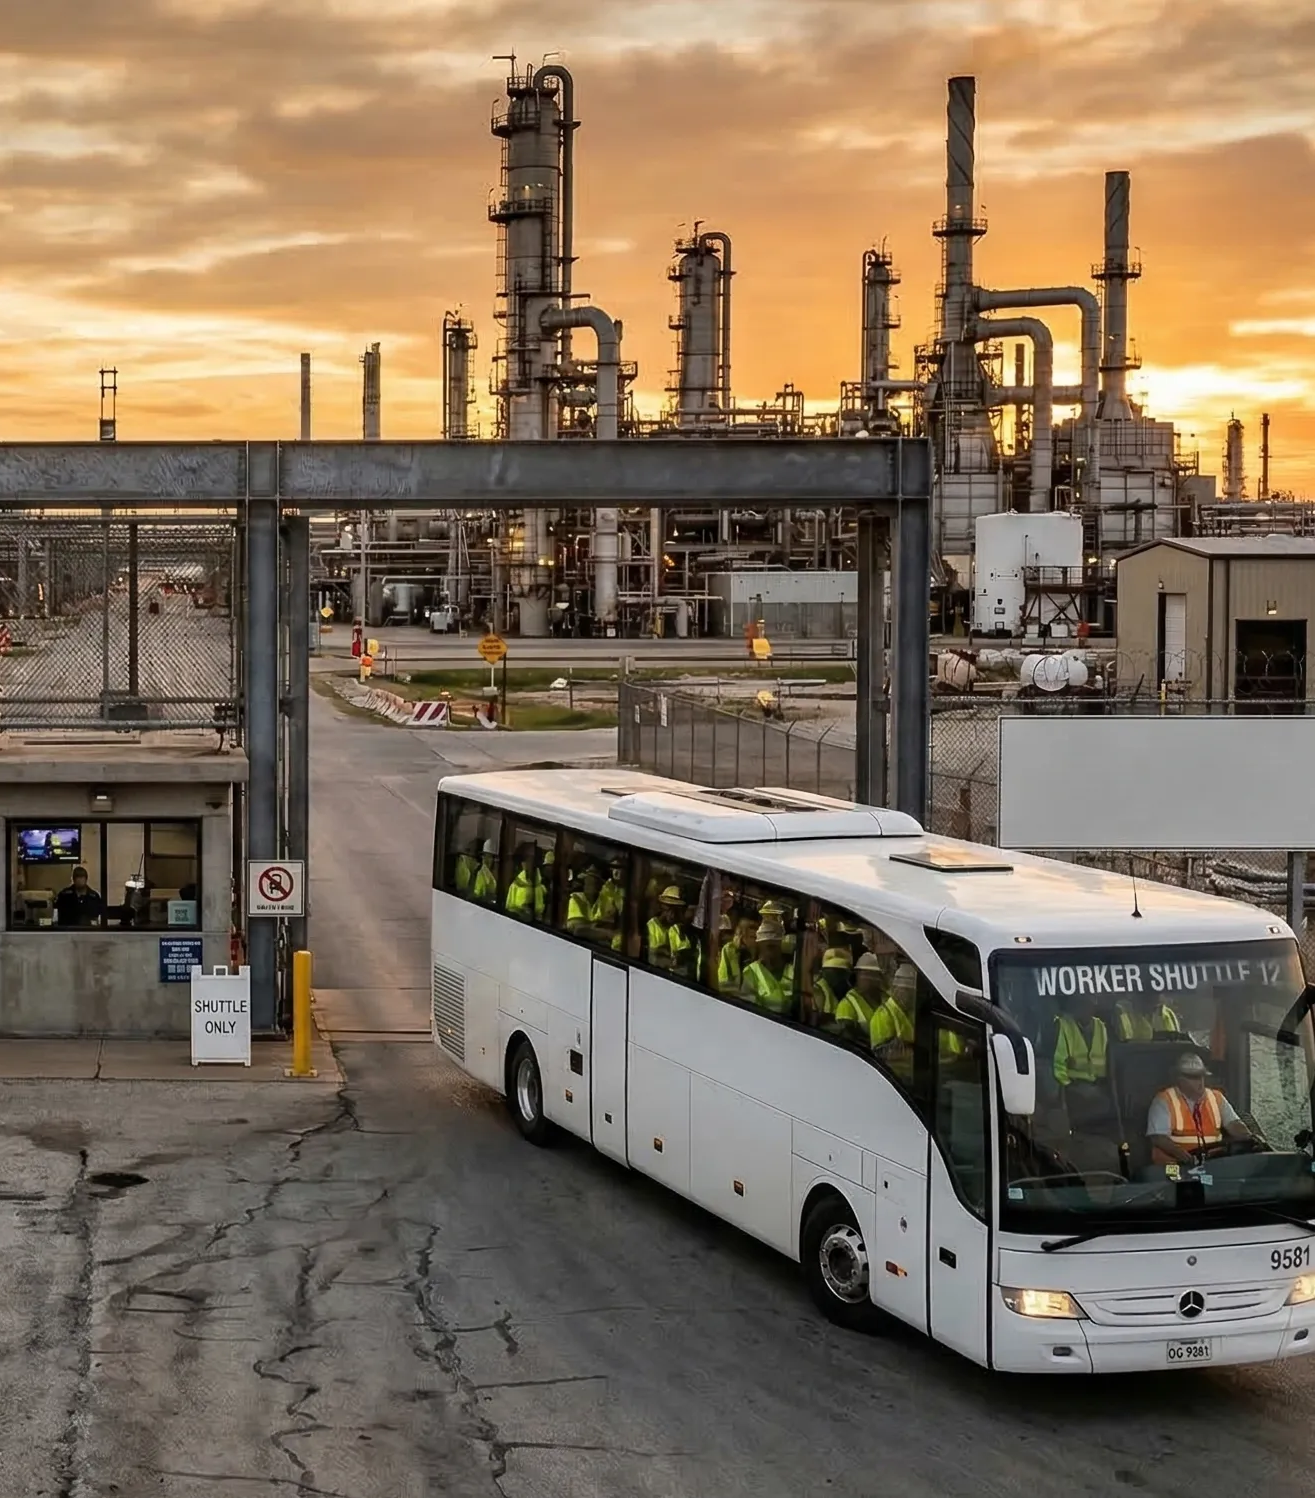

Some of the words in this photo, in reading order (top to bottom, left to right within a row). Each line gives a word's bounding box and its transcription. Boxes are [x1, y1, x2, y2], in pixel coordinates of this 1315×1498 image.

[1035, 963, 1144, 996] WORKER
[1257, 960, 1282, 987] 12
[194, 1000, 248, 1013] SHUTTLE
[205, 1021, 237, 1034] ONLY
[1271, 1244, 1310, 1270] 9581
[1168, 1347, 1184, 1359] OG
